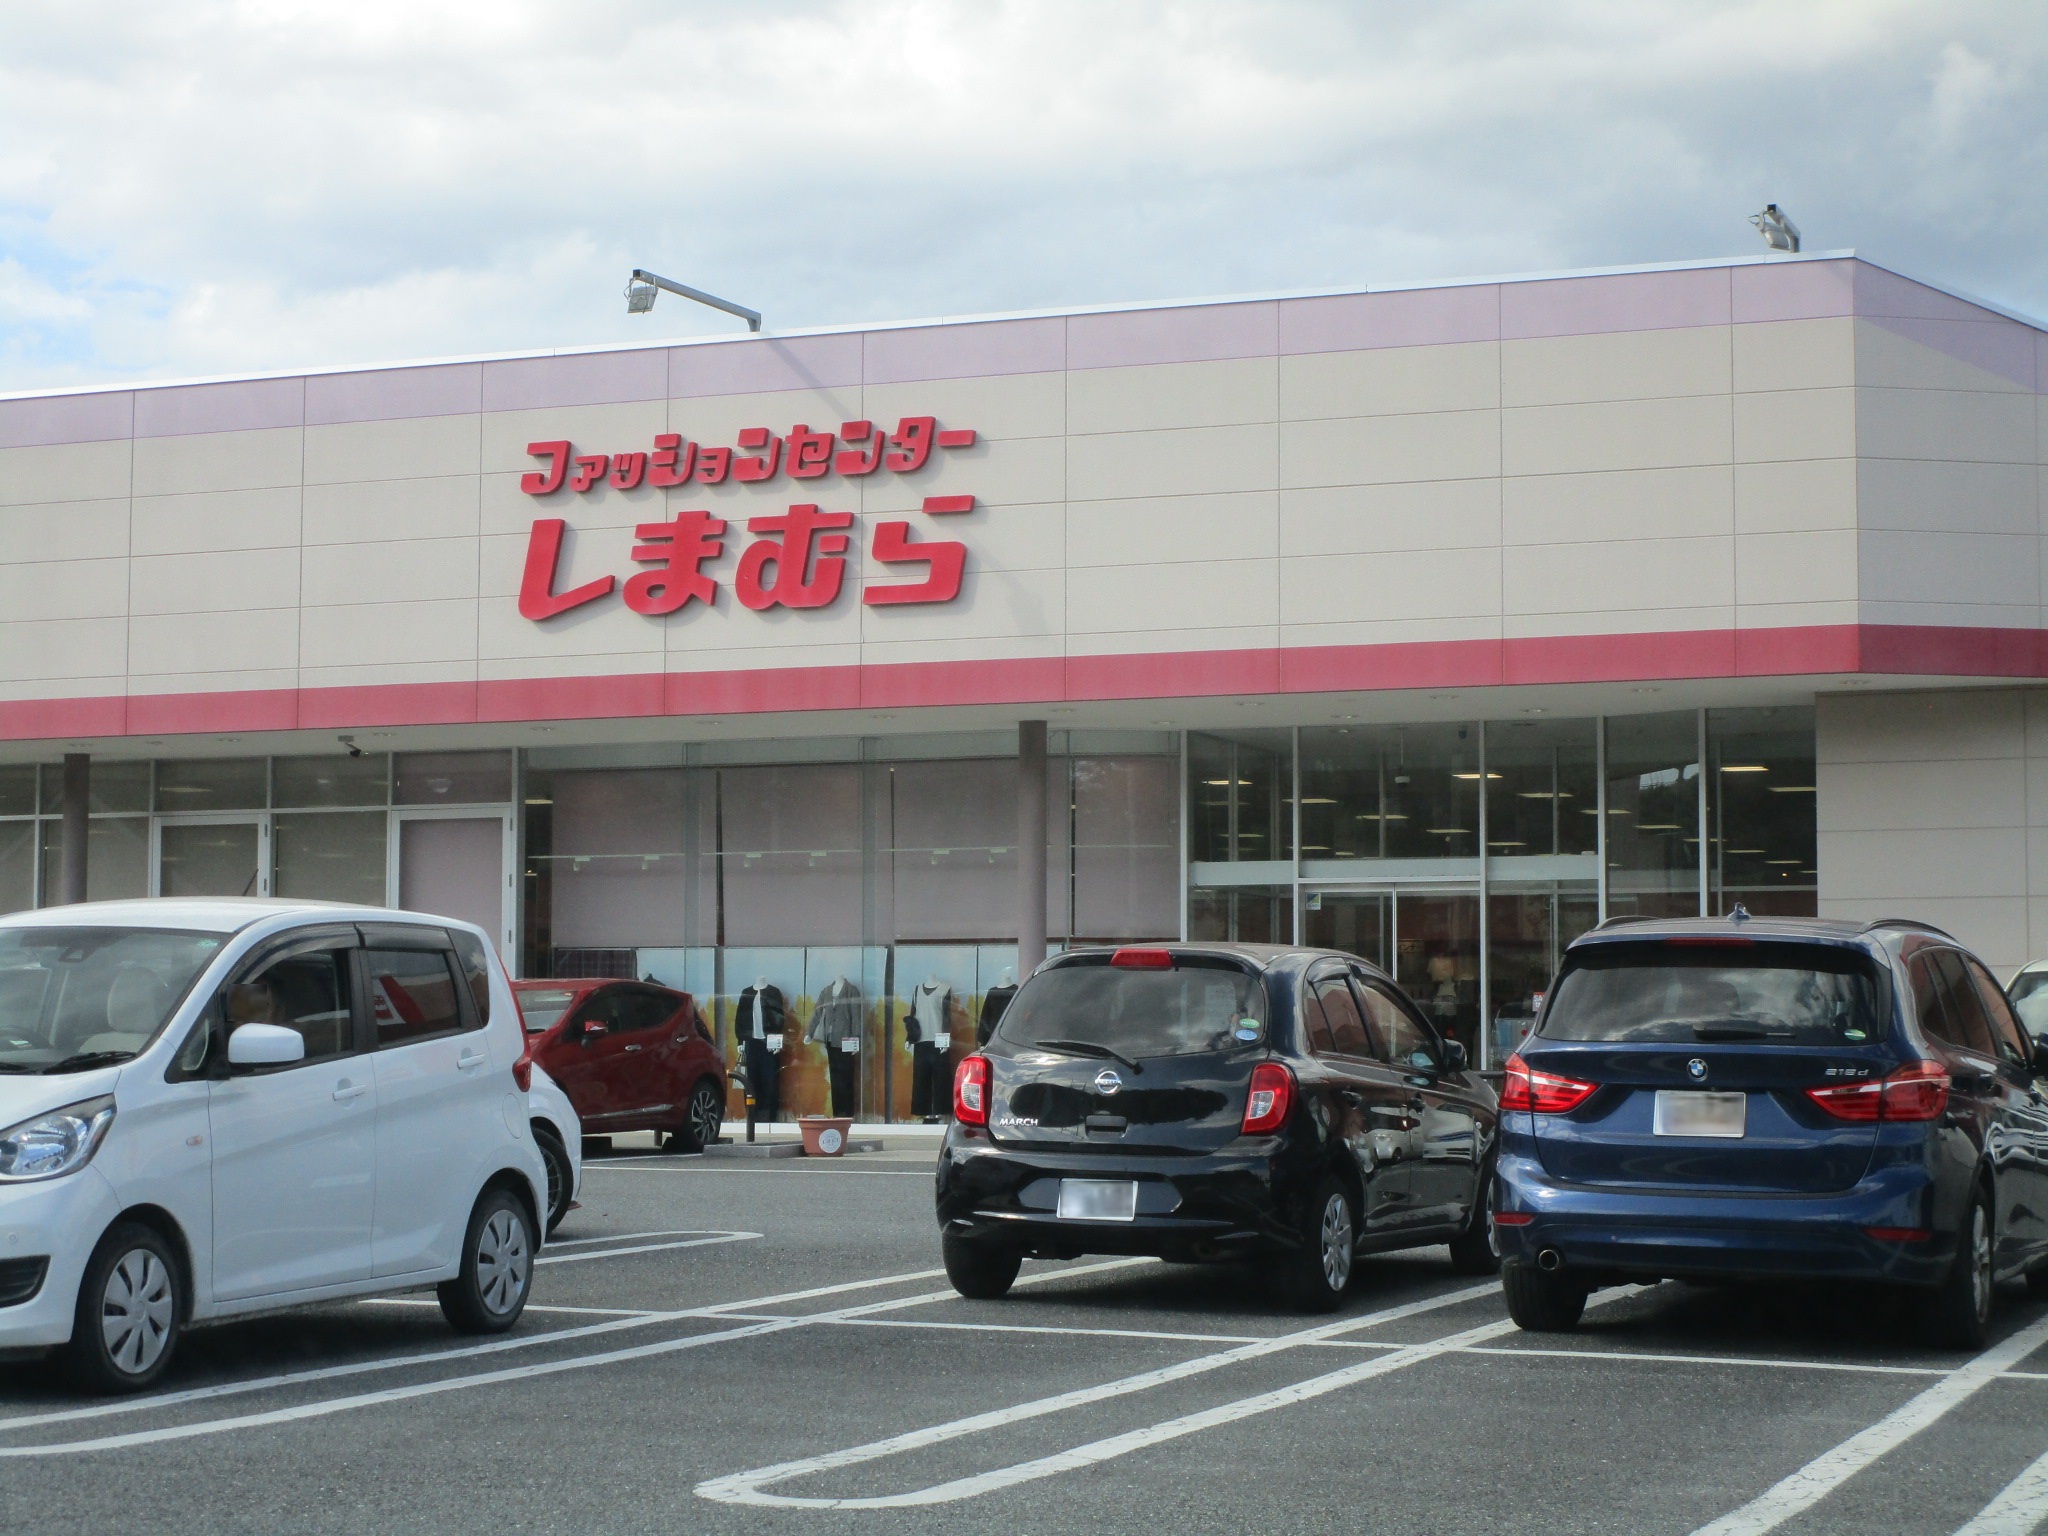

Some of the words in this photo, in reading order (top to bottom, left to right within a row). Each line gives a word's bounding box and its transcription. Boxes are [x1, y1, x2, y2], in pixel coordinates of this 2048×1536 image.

[520, 416, 976, 494] ファッションセンター
[518, 495, 975, 620] しまむら
[999, 1117, 1039, 1127] MARCH
